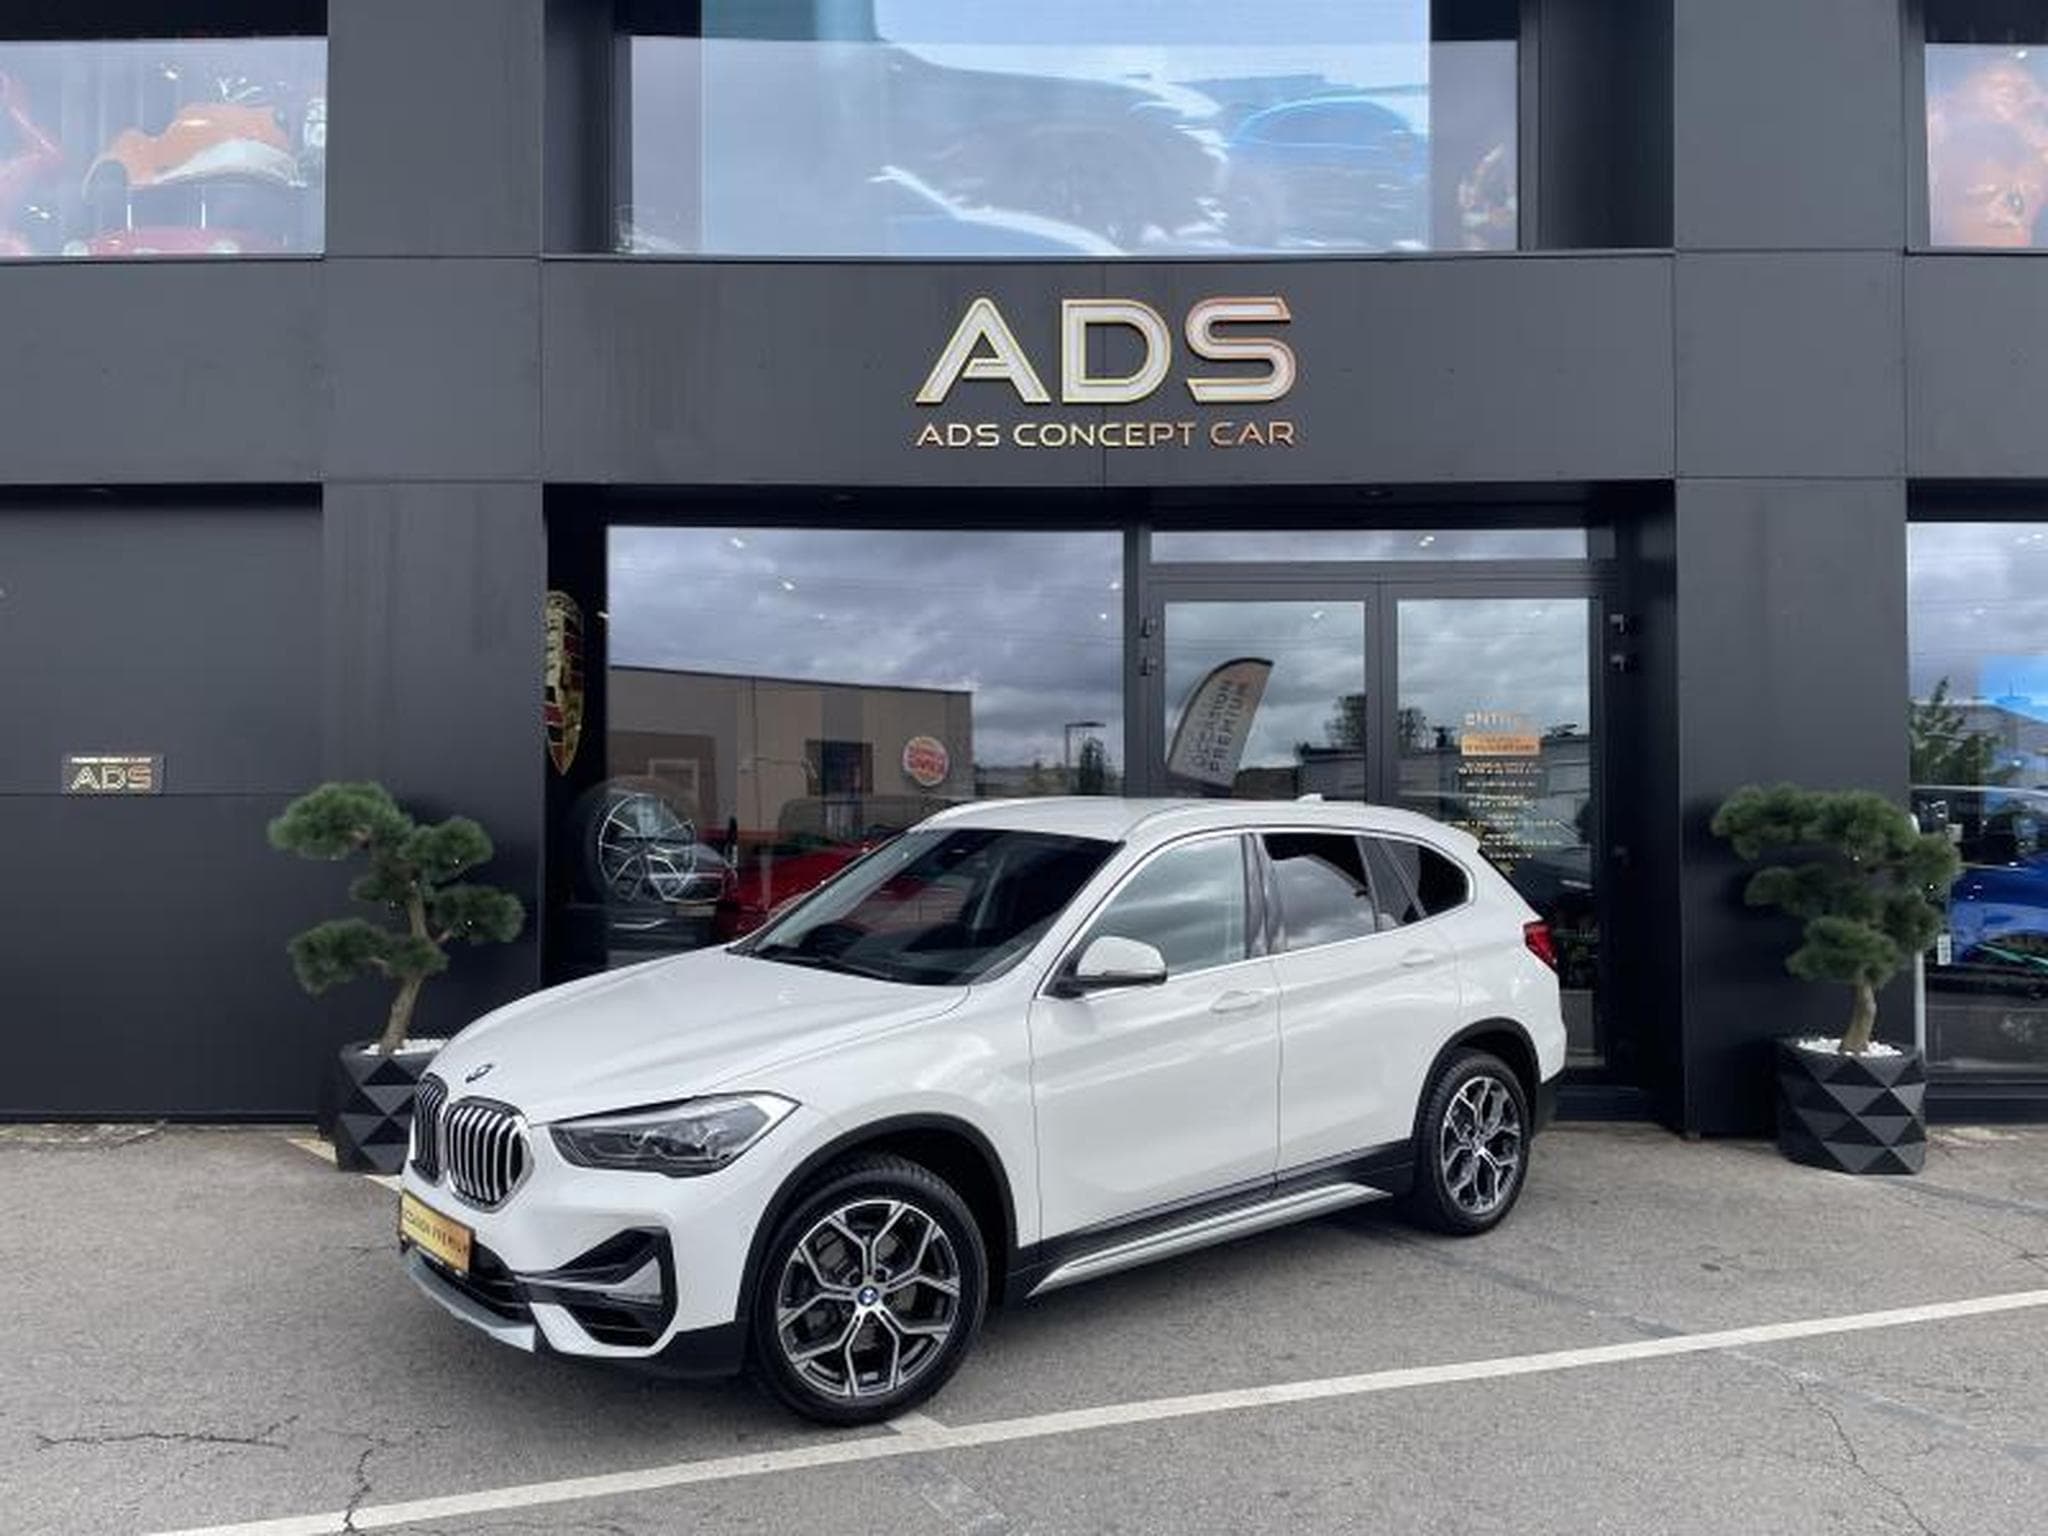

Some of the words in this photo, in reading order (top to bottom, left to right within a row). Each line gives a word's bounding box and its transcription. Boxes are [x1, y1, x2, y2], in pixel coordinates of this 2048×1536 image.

[914, 296, 1297, 404] ADS
[915, 422, 1000, 448] ADS
[1013, 422, 1196, 448] CONCEPT
[1210, 421, 1295, 447] CAR
[70, 764, 152, 790] ADS
